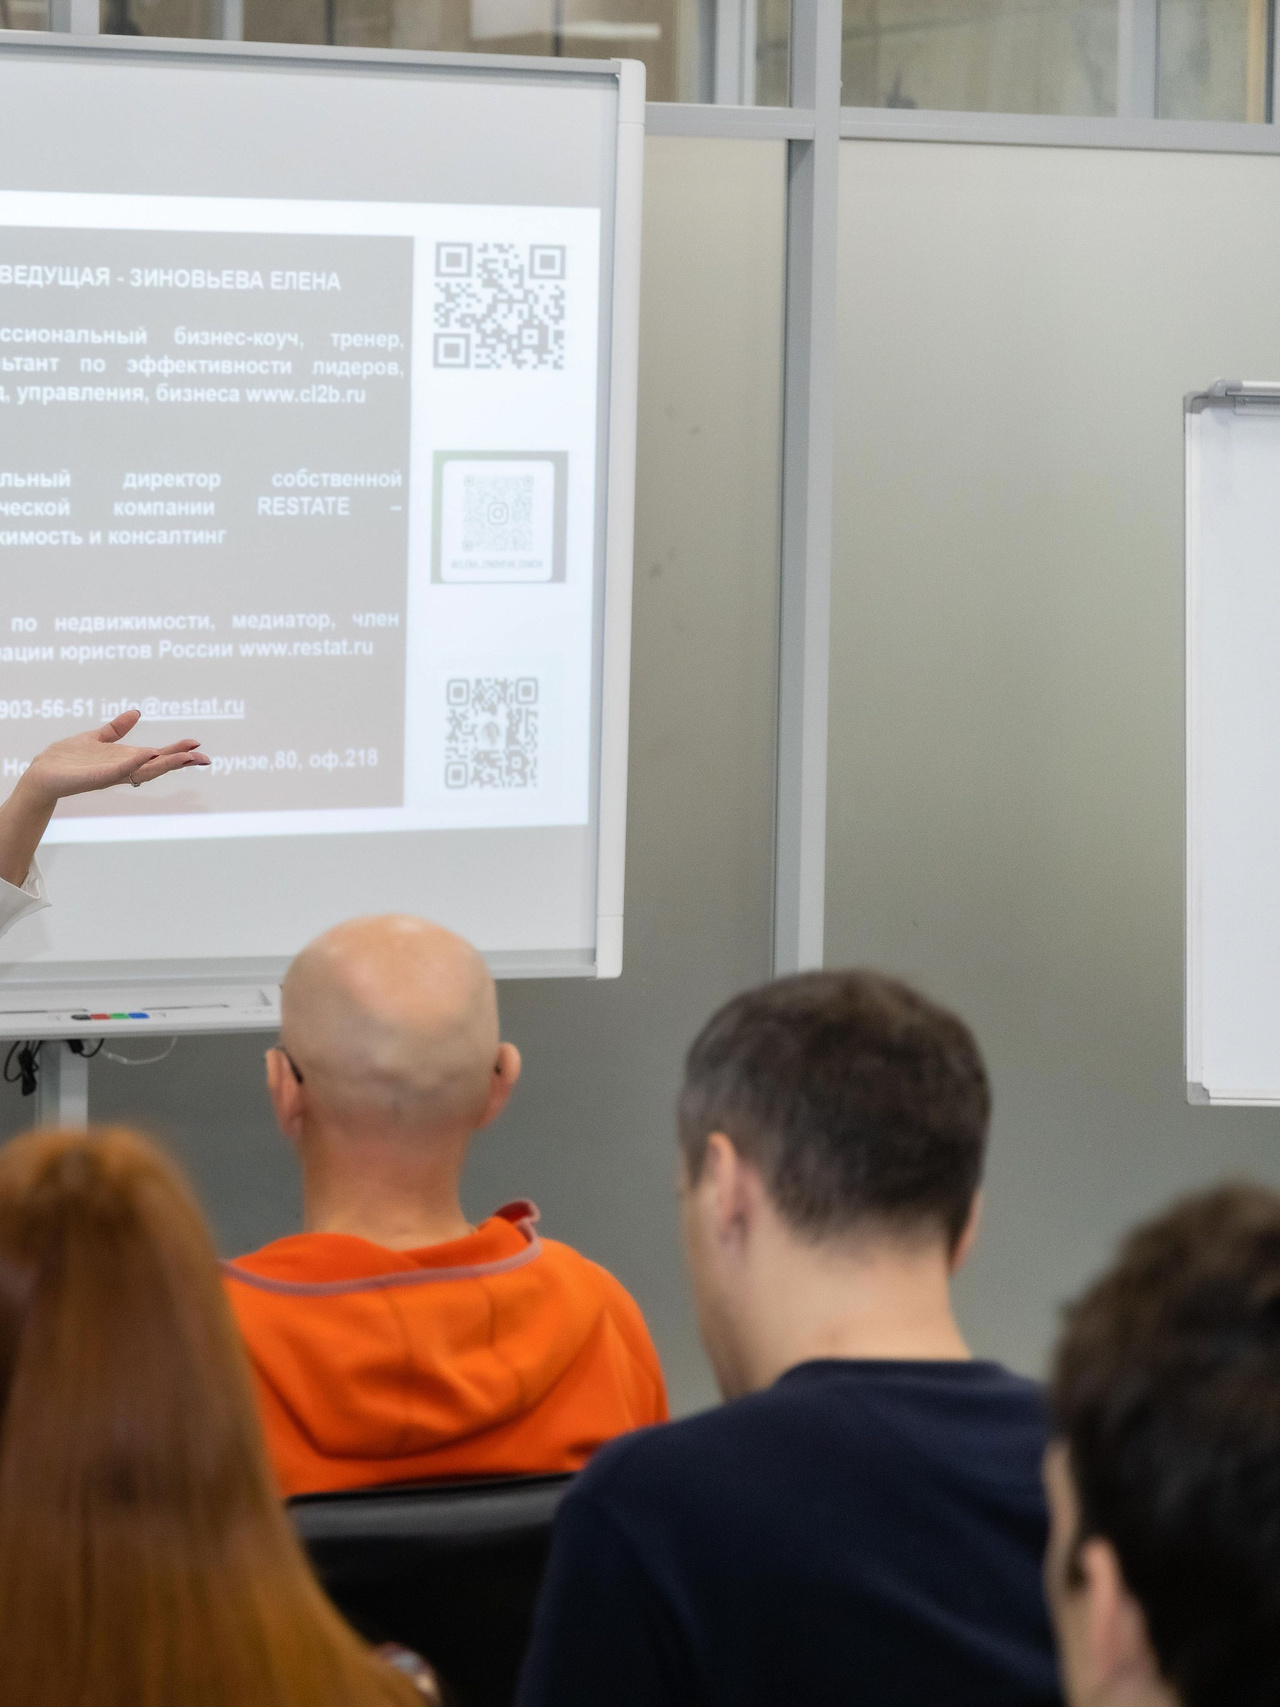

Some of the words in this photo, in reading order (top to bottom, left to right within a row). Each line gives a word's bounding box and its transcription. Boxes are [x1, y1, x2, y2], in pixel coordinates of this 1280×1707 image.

[129, 266, 266, 291] ЗИНОВЬЕВА
[269, 269, 343, 292] ЕЛЕНА
[173, 324, 306, 352] бизнес-коуч,
[330, 329, 407, 354] тренер,
[79, 356, 108, 374] по
[126, 353, 294, 379] эффективности
[312, 359, 404, 381] лидеров,
[16, 384, 151, 407] управления,
[155, 381, 242, 404] бизнеса
[245, 383, 368, 405] www.cl2b.ru
[122, 471, 223, 493] директор
[271, 466, 403, 489] собственной
[113, 500, 217, 518] компании
[257, 495, 351, 517] RESTATE
[88, 529, 104, 547] и
[107, 528, 228, 547] консалтинг
[10, 615, 39, 634] по
[54, 613, 217, 635] недвижимости,
[231, 612, 337, 633] медиатор,
[352, 611, 400, 628] член
[59, 643, 154, 666] юристов
[158, 638, 235, 660] России
[238, 637, 375, 658] www.restat.ru
[100, 695, 247, 722] info@restat.ru
[196, 749, 304, 777] рунзе,80,
[308, 746, 380, 773] оф.218
